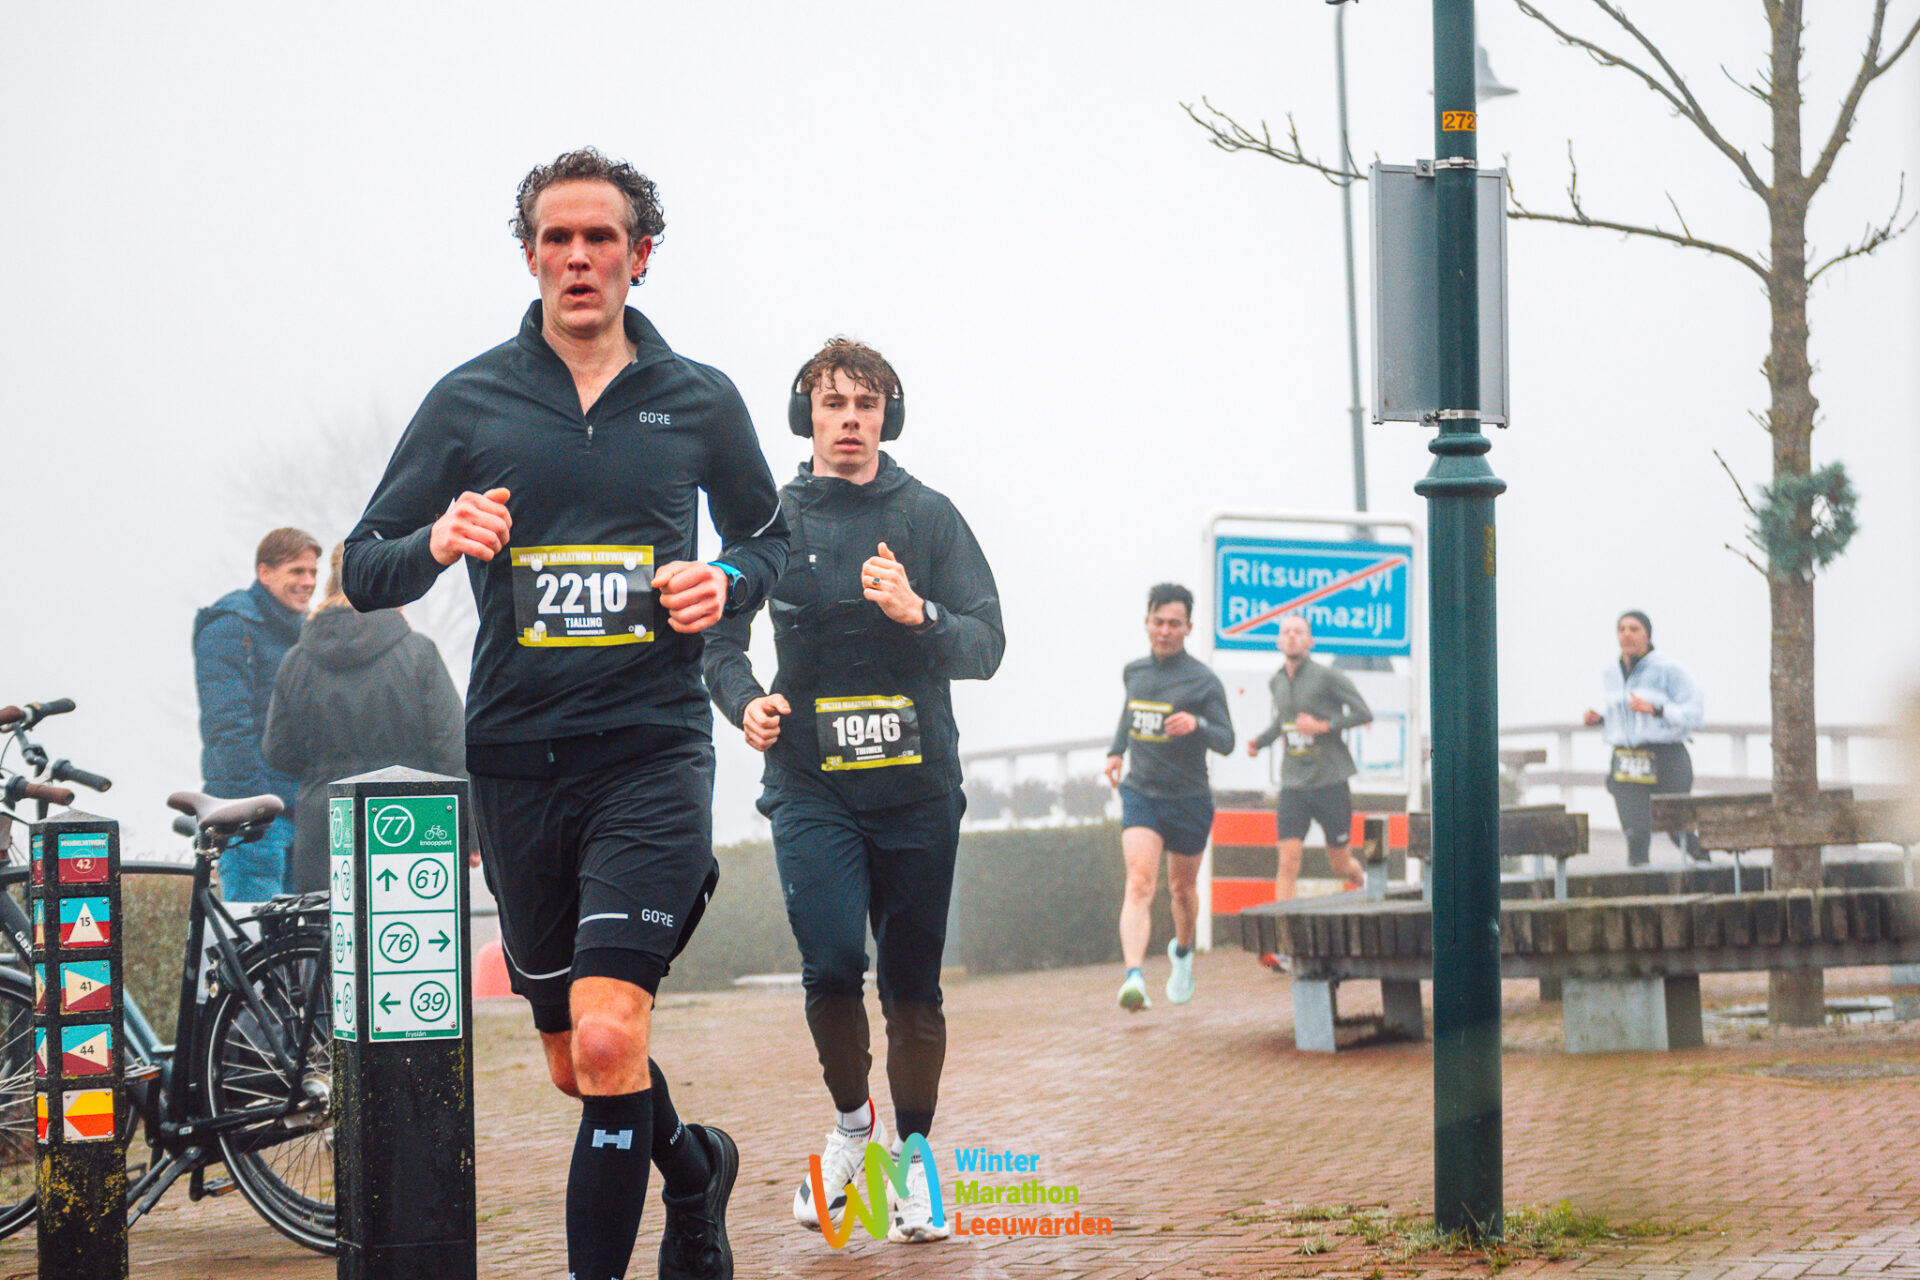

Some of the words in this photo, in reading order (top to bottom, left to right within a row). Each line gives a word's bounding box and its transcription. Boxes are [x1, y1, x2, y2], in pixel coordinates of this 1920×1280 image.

[1444, 113, 1476, 129] 272
[639, 411, 671, 425] GORE
[536, 572, 628, 615] 2210
[832, 713, 901, 747] 1946
[380, 816, 408, 836] 77
[76, 858, 92, 870] 42
[415, 869, 440, 889] 61
[80, 917, 91, 928] 15
[641, 908, 674, 928] GORE
[385, 933, 413, 953] 76
[80, 981, 92, 992] 41
[417, 992, 445, 1012] 39
[79, 1045, 95, 1056] 44
